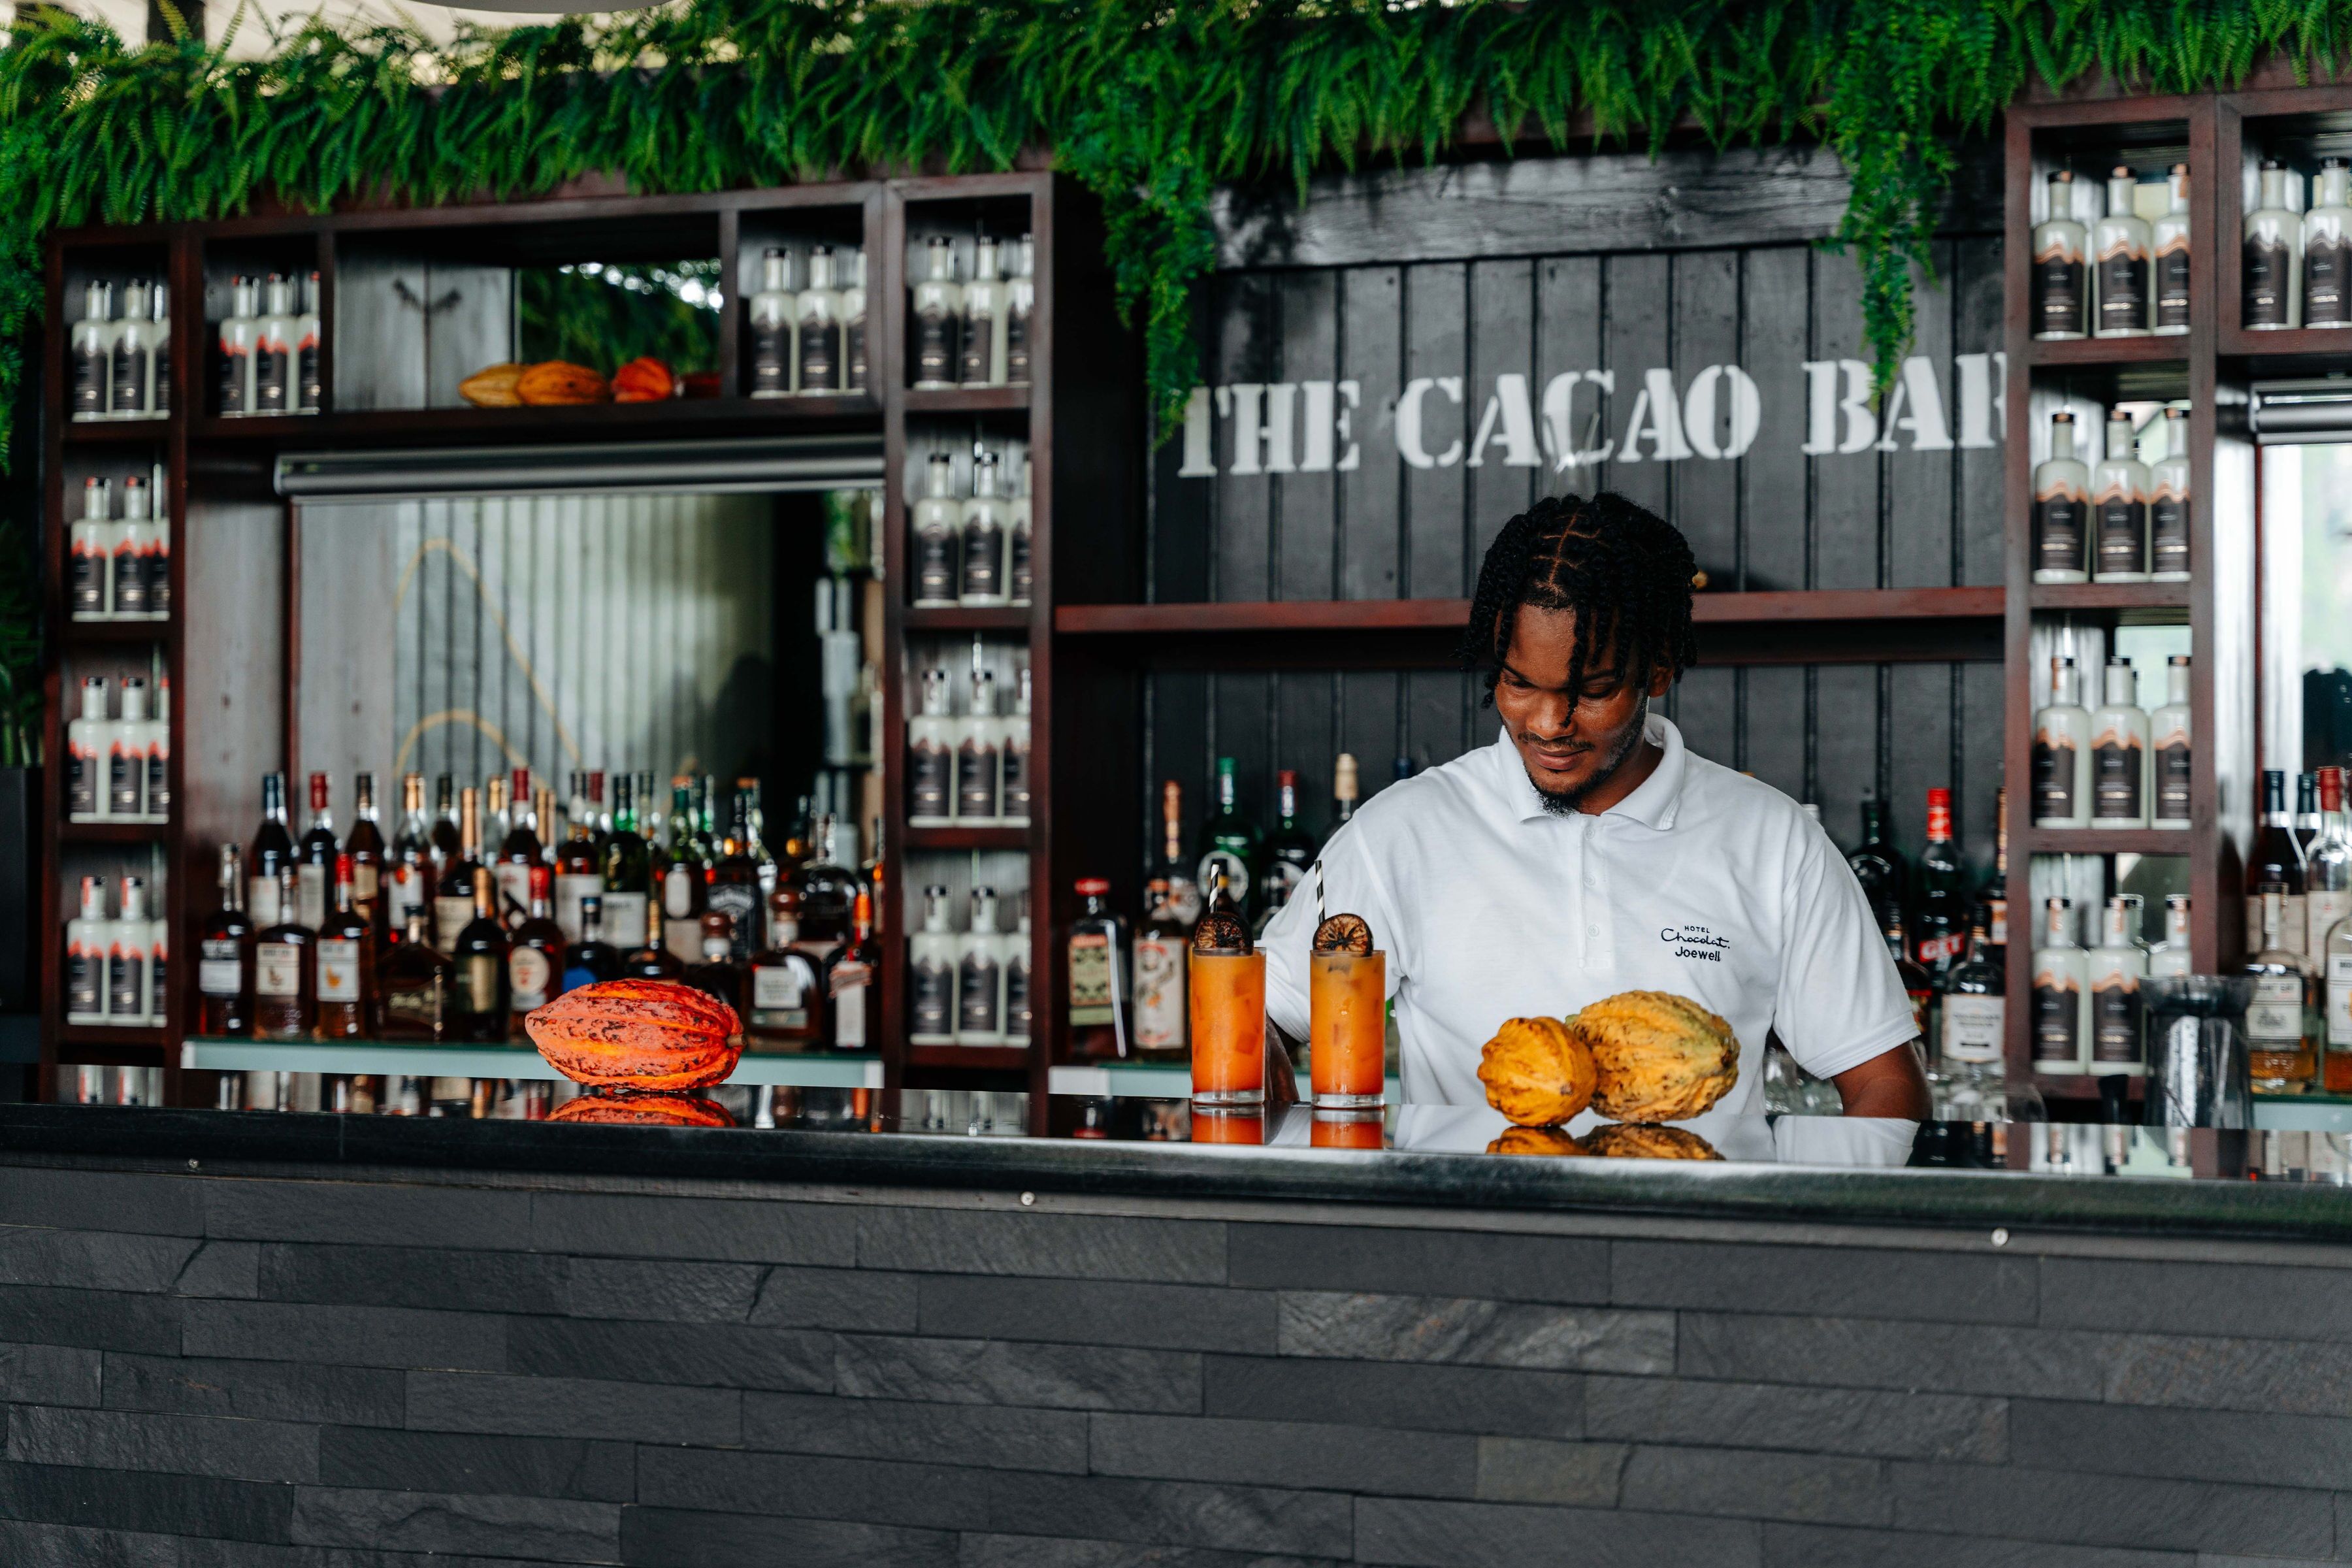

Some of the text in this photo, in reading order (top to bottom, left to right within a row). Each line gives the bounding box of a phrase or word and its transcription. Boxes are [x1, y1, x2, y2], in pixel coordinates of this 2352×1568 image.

[1177, 380, 1361, 478] THE
[1395, 365, 1761, 470] CACAO
[1675, 946, 1721, 962] Joewell
